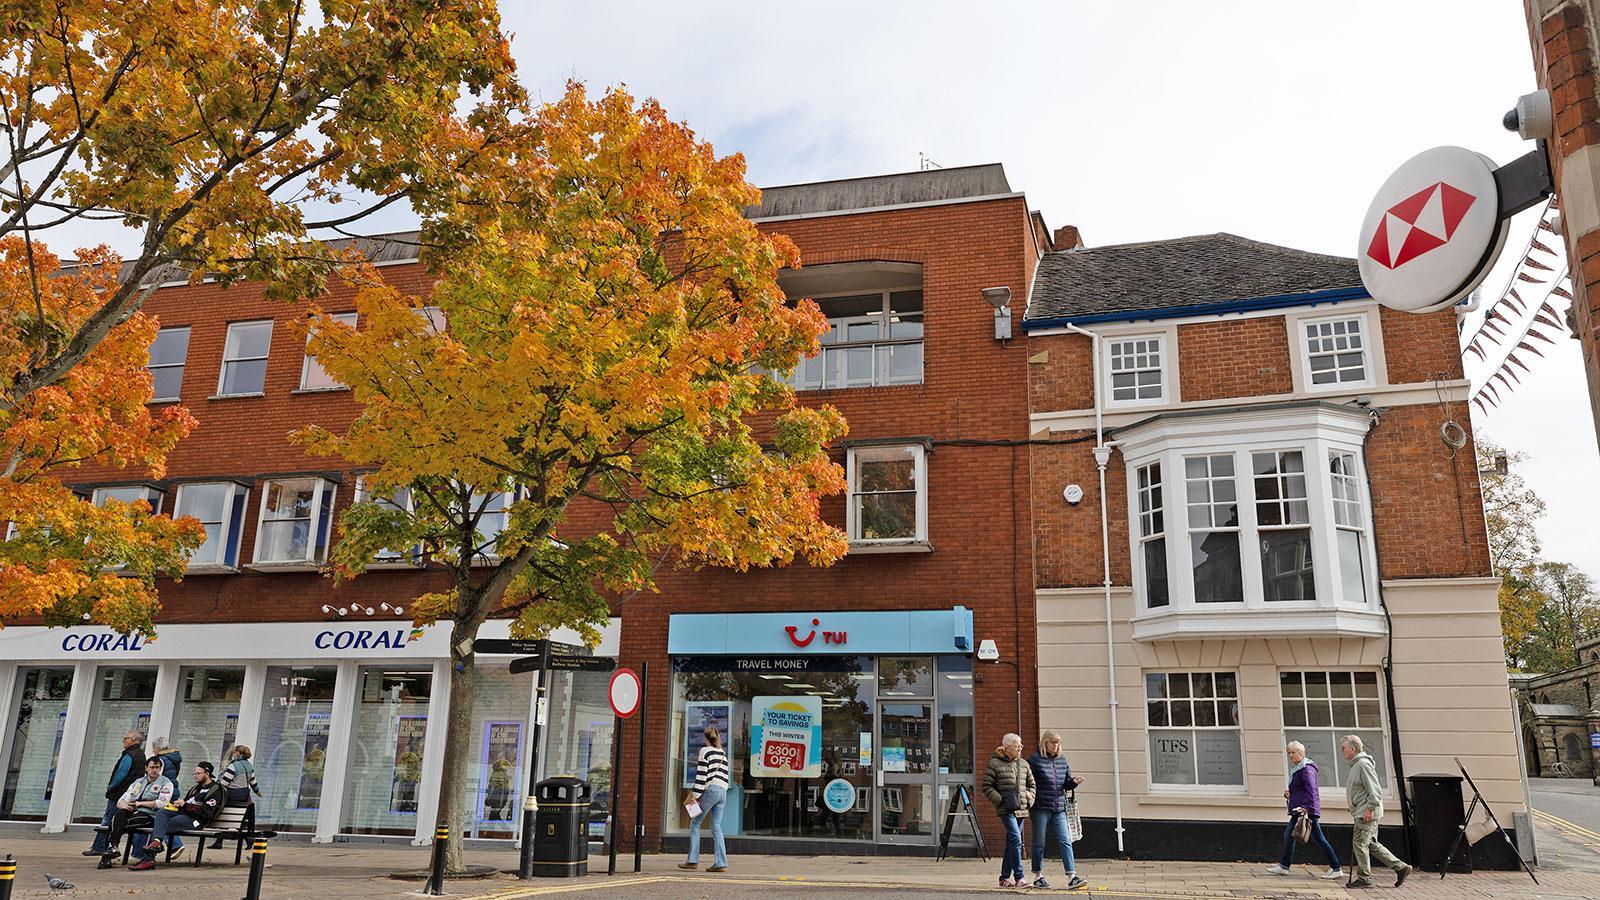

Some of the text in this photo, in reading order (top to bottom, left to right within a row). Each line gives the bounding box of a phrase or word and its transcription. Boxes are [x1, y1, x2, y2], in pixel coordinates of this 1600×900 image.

[62, 633, 142, 652] CORAL
[314, 630, 406, 650] CORAL
[822, 631, 848, 645] TUI
[736, 659, 809, 669] TRAVEL MONEY
[767, 711, 812, 722] YOUR TICKET
[768, 718, 809, 728] TO SAVINGS
[783, 732, 805, 740] WINTER
[766, 745, 797, 757] £300
[1158, 739, 1189, 753] TFS
[770, 755, 792, 765] OFF
